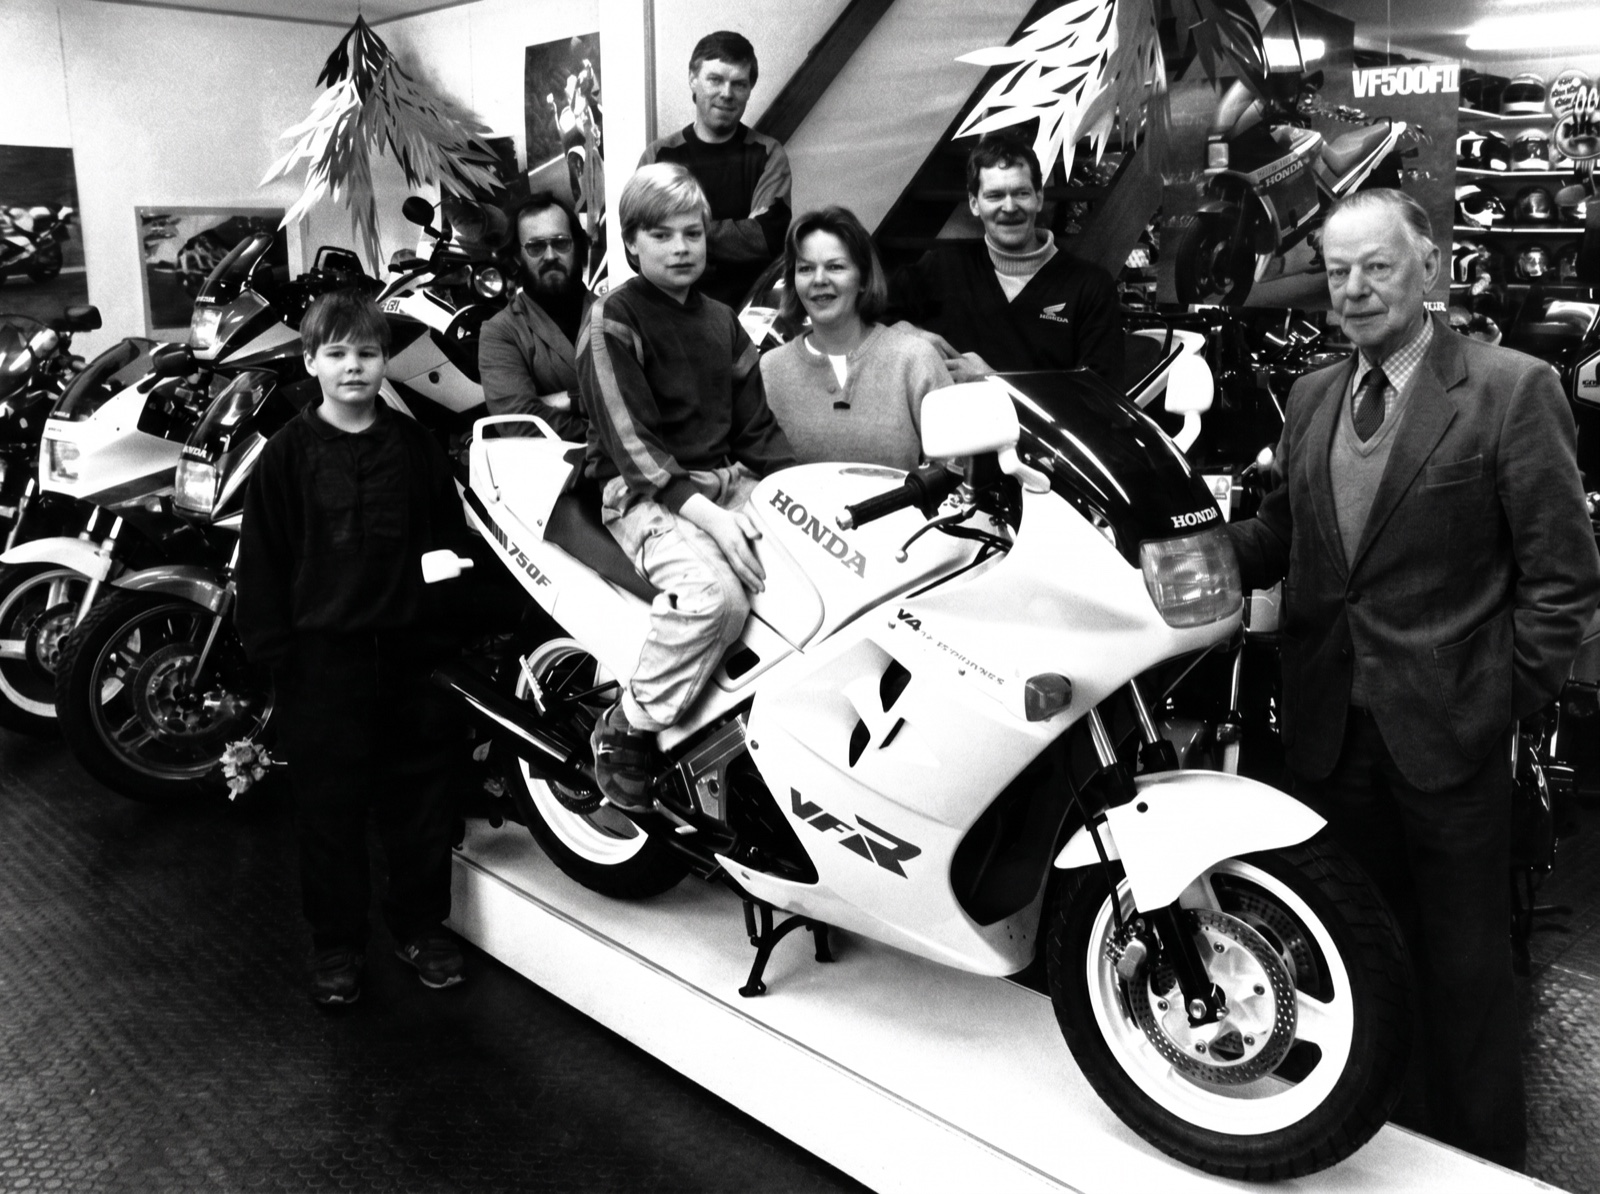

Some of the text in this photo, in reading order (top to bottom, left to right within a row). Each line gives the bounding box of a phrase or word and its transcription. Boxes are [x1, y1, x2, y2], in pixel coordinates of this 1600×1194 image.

[1265, 160, 1303, 187] HONDA
[769, 489, 866, 579] HONDA
[1171, 506, 1218, 528] HONDA
[508, 541, 552, 587] 750F
[897, 608, 921, 631] V4
[790, 787, 922, 879] VFR
